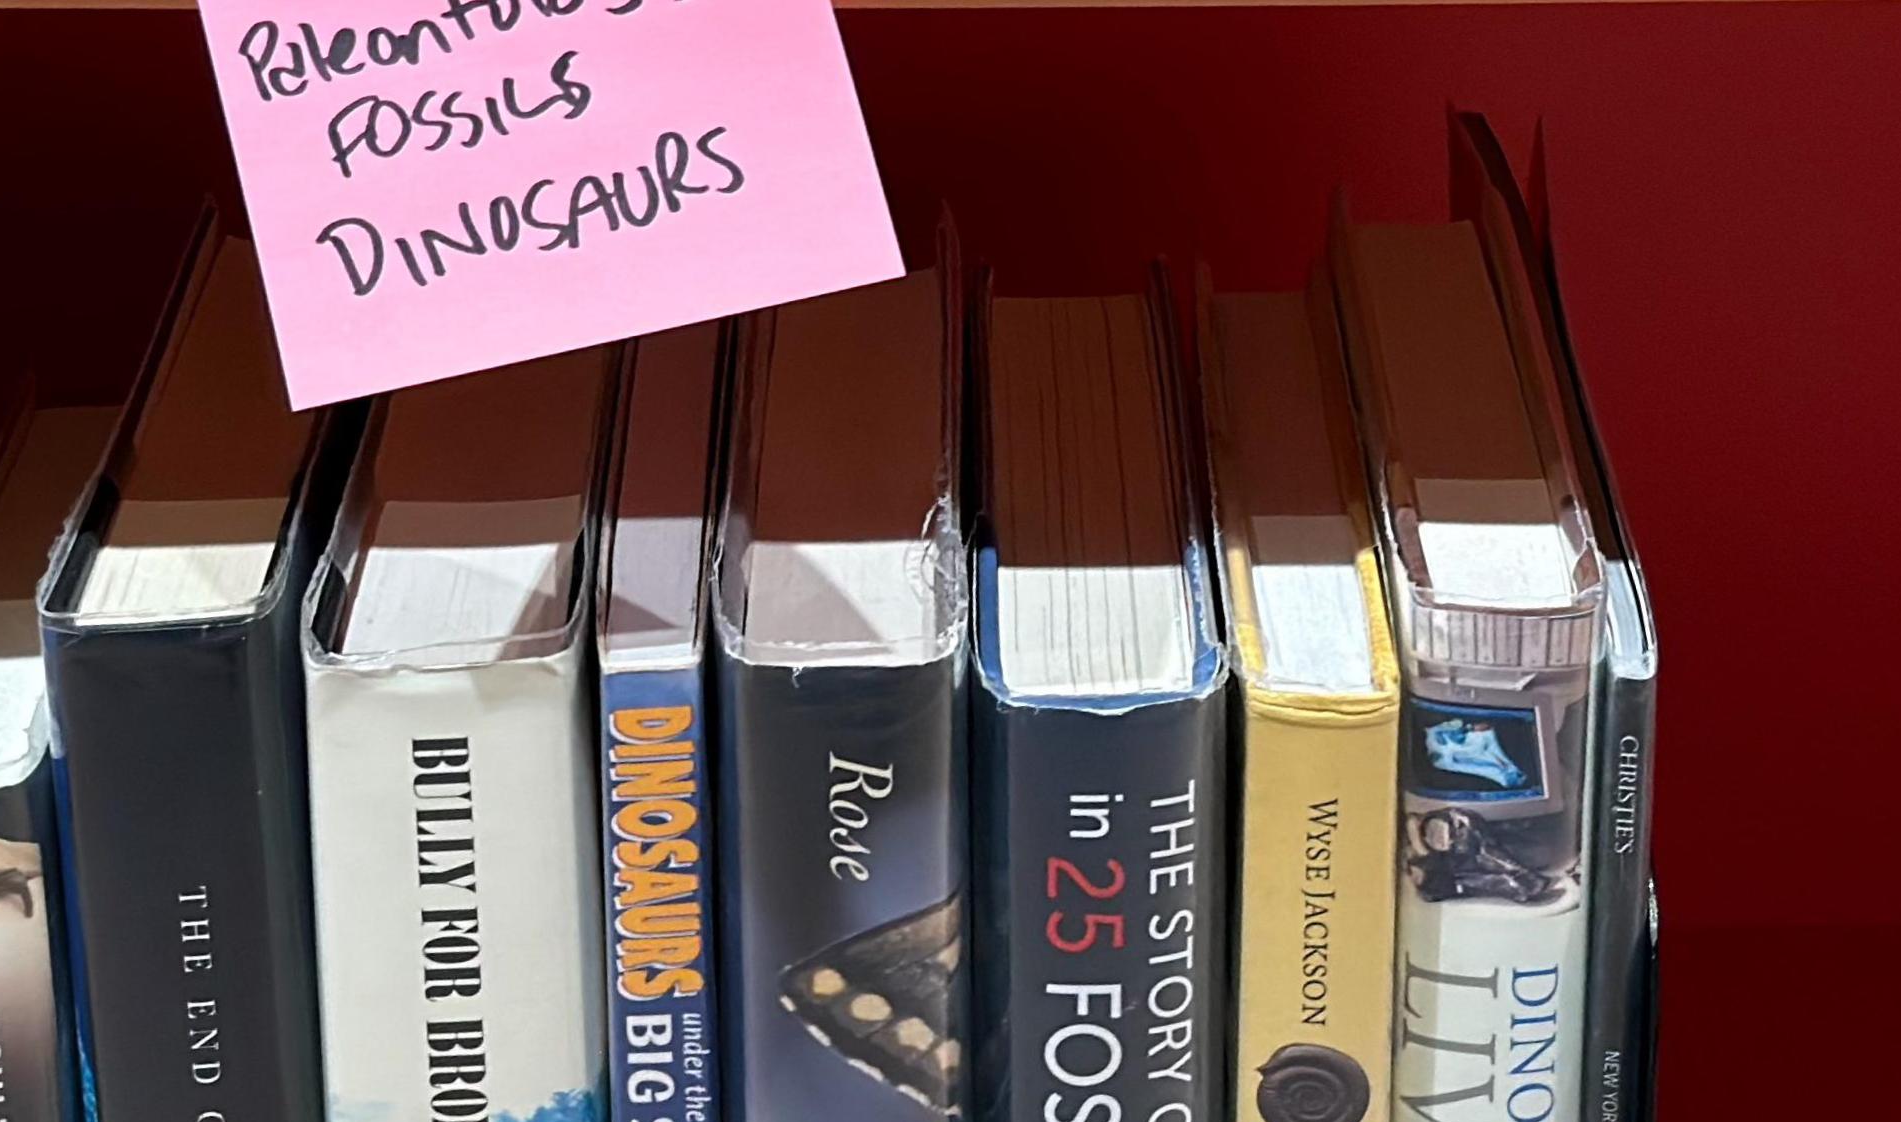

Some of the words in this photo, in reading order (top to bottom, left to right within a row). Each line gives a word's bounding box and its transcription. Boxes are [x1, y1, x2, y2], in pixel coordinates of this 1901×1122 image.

[328, 51, 592, 178] FOSSILS
[315, 127, 744, 296] DINOSAURS
[411, 737, 477, 894] BULLY
[607, 705, 706, 1001] DINOSAURS
[827, 751, 893, 883] Rose
[1068, 792, 1124, 840] in
[1148, 779, 1196, 895] THE
[1304, 797, 1339, 882] WYSE
[178, 885, 213, 974] THE
[1044, 855, 1127, 954] 25
[420, 906, 483, 1003] FOR
[1147, 908, 1194, 1082] STORY
[1300, 889, 1336, 1027] JACKSON
[187, 999, 221, 1085] END
[625, 1014, 675, 1105] BIG
[681, 1012, 711, 1081] under
[1602, 1051, 1621, 1089] NEW
